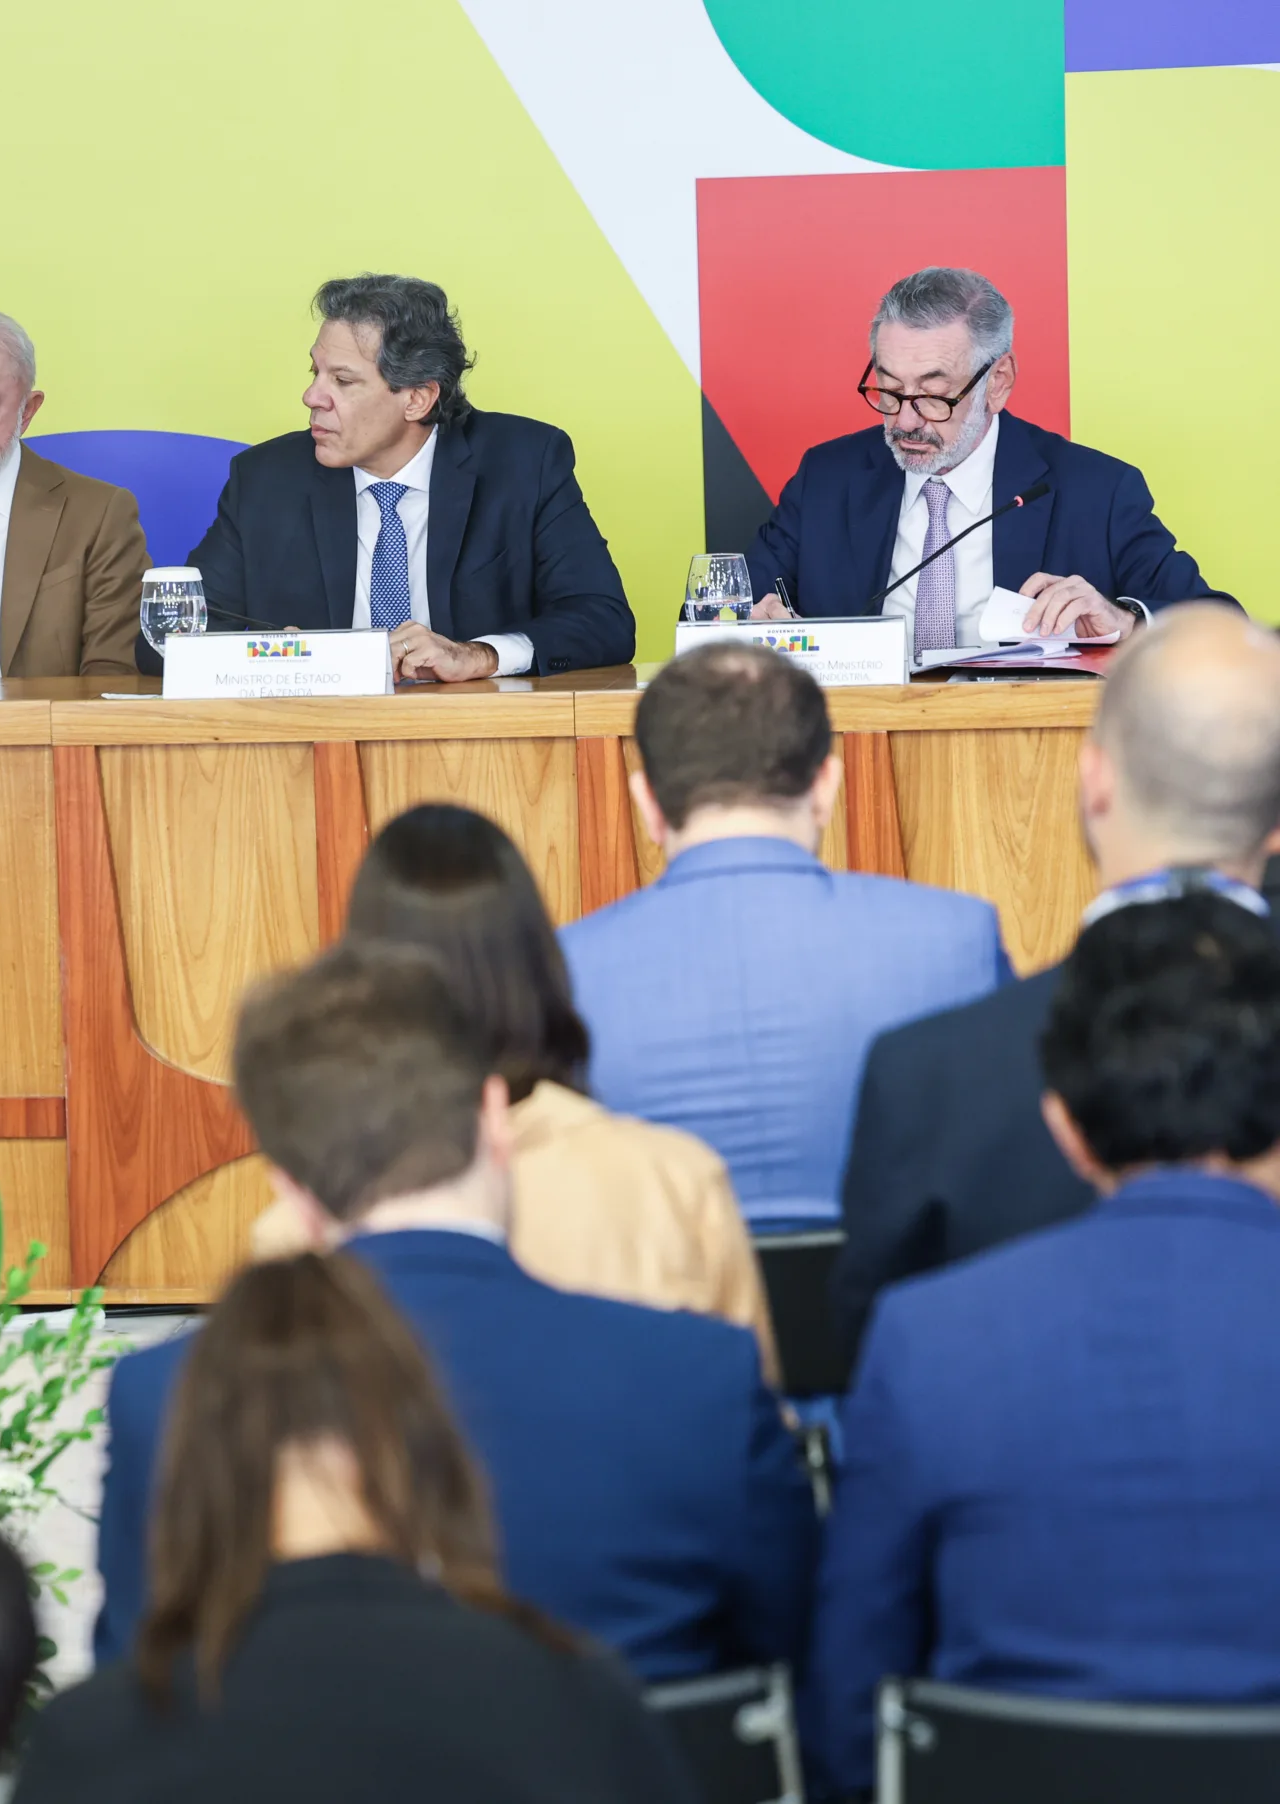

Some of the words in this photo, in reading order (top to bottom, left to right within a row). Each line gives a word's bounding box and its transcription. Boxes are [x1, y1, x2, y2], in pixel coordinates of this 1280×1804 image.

[247, 640, 312, 657] BRASIL
[827, 658, 883, 671] MINISTÉRIO
[215, 673, 272, 685] MINISTRO
[276, 674, 290, 684] DE
[294, 672, 341, 684] ESTADO
